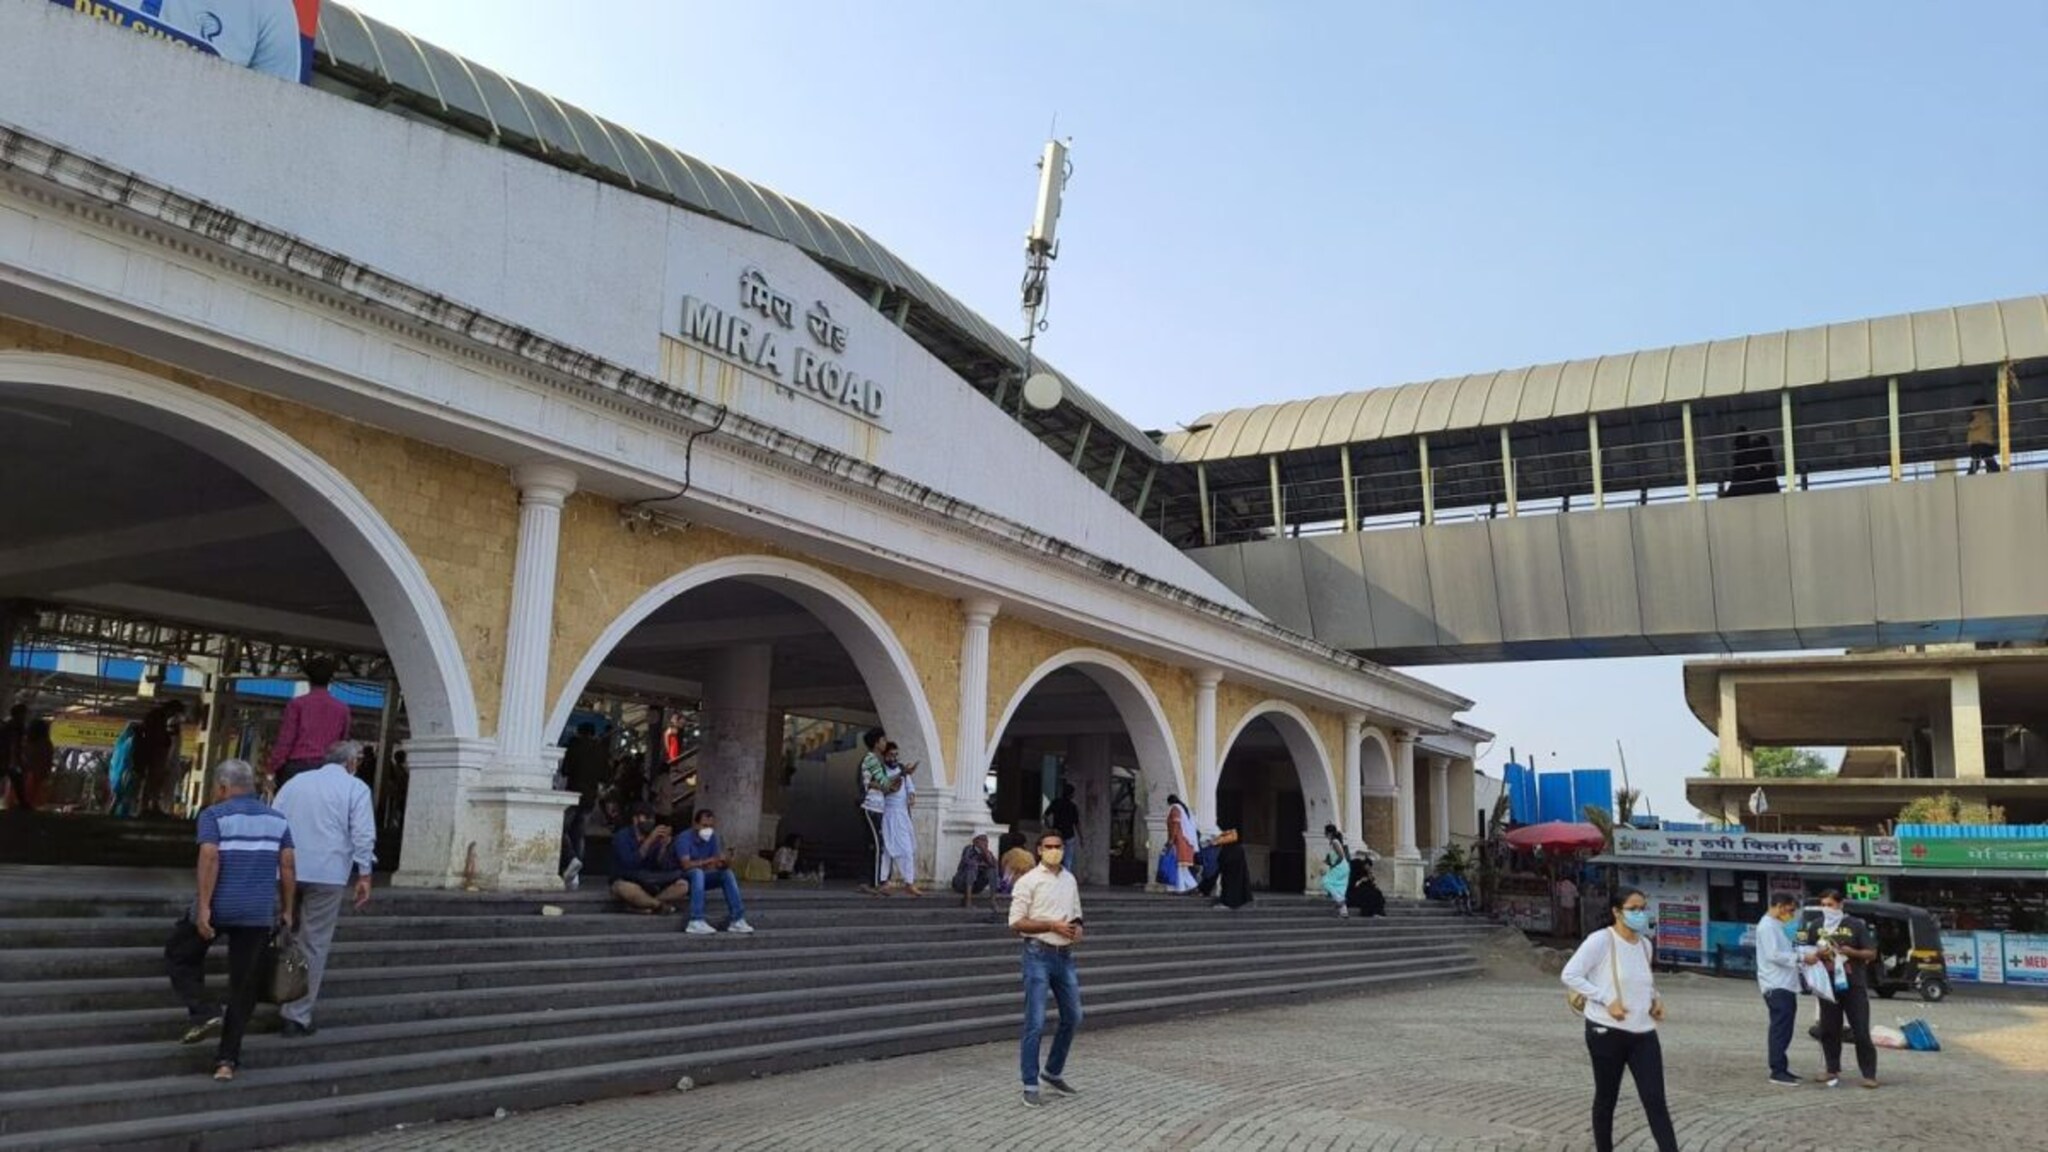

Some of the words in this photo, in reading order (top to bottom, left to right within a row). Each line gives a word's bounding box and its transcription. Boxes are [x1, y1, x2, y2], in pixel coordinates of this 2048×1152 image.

[681, 294, 783, 377] MIRA
[793, 346, 886, 419] ROAD
[739, 266, 796, 330] मिरा
[806, 300, 850, 354] रोड
